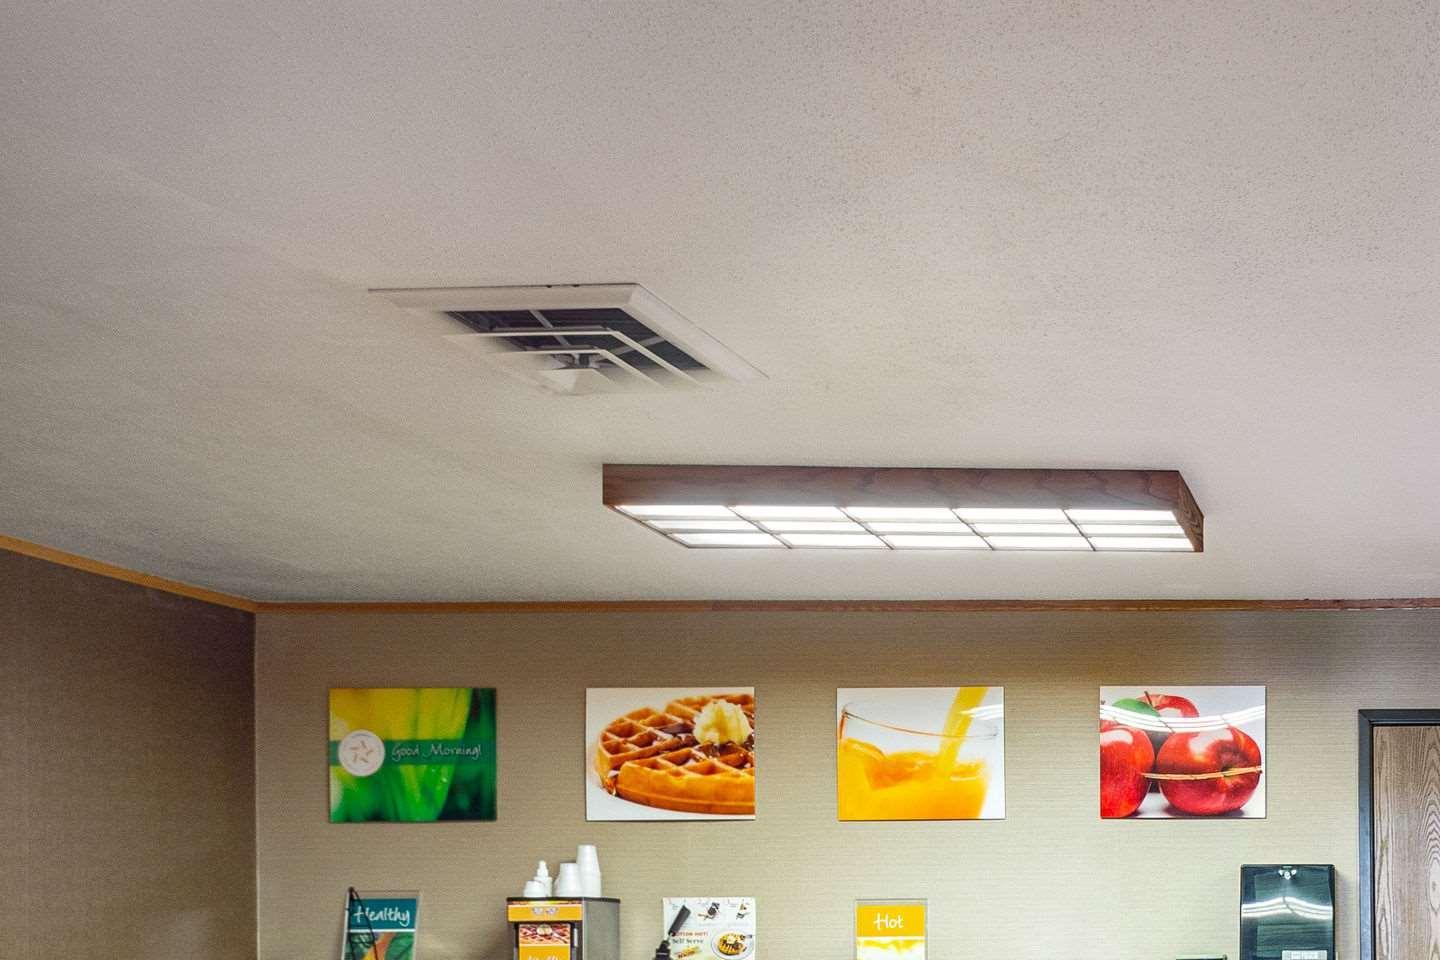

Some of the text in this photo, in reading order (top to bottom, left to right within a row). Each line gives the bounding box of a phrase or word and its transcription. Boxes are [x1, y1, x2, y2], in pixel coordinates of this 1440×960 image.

[391, 743, 481, 761] Good Morning!
[353, 905, 410, 927] Healthy
[873, 912, 905, 931] Hot
